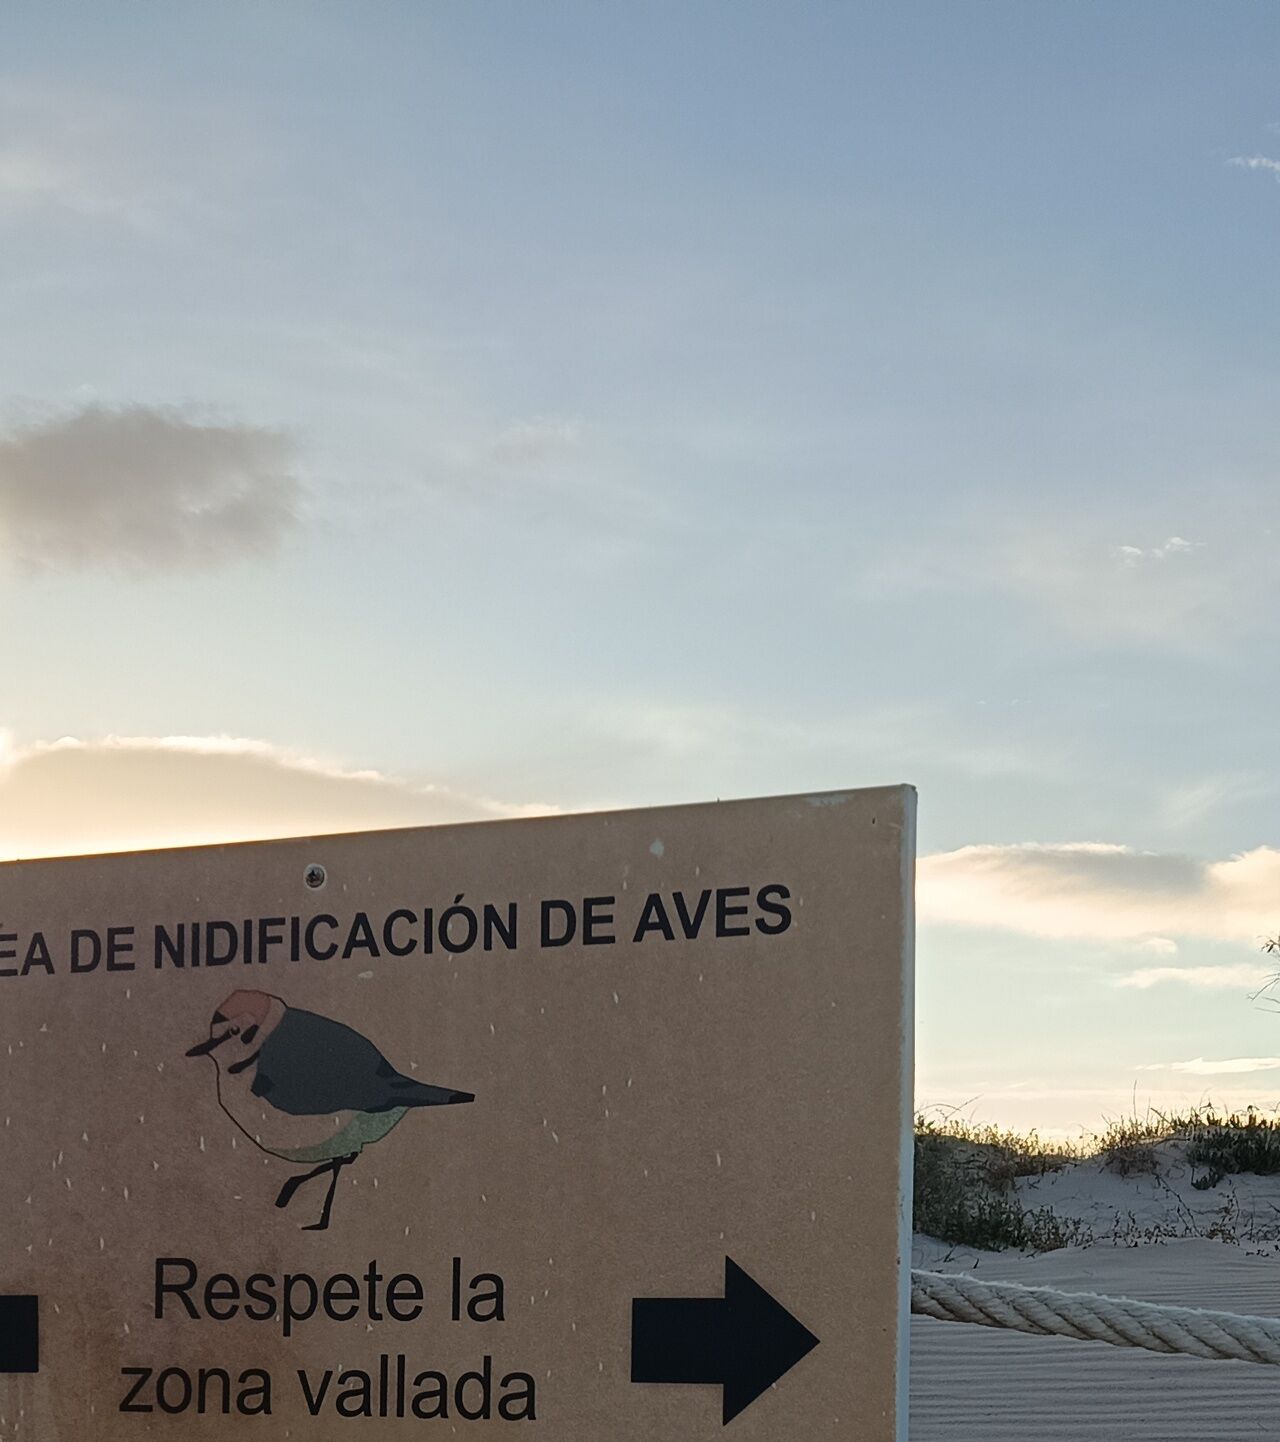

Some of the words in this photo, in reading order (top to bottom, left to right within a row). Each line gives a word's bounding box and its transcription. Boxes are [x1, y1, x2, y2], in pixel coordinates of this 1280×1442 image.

[70, 926, 136, 973] DE
[154, 893, 518, 970] NIDIFICACIÓN
[540, 895, 617, 948] DE
[632, 884, 793, 943] AVES
[153, 1256, 425, 1338] Respete
[450, 1256, 506, 1322] la
[119, 1365, 273, 1416] zona
[296, 1353, 538, 1422] vallada
